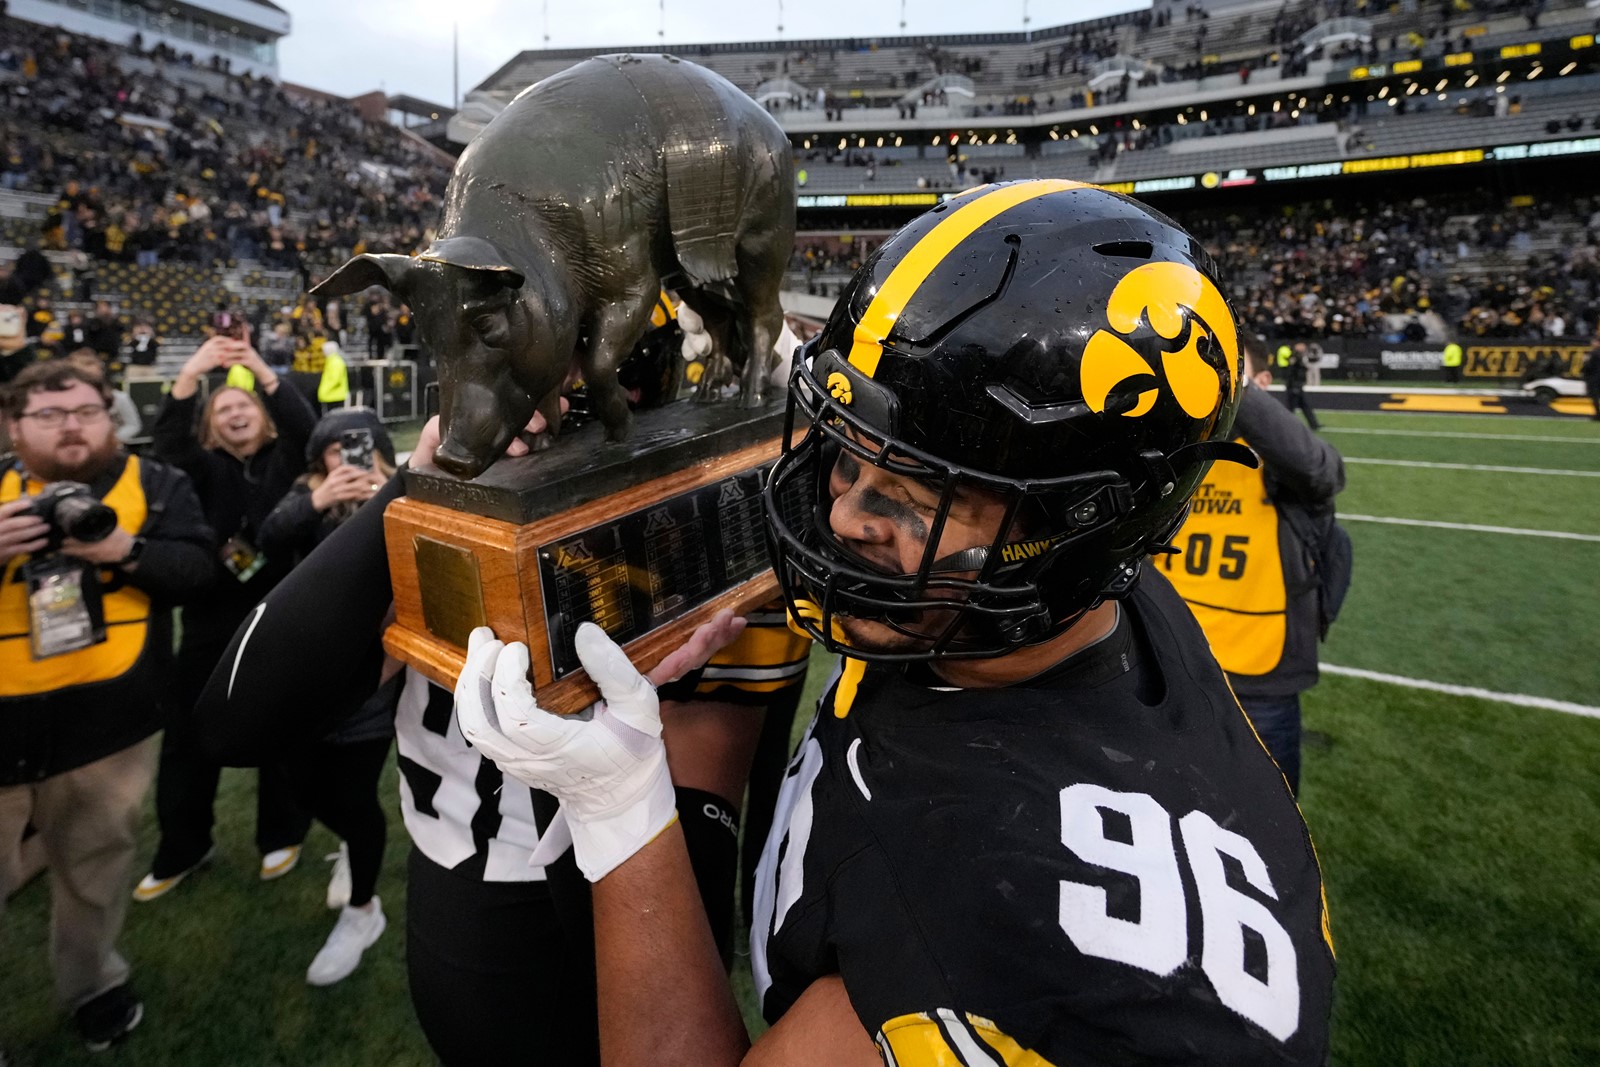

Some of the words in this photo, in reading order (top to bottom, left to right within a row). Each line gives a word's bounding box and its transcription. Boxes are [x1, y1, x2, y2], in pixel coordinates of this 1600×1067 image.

[587, 576, 602, 588] 2006
[588, 587, 602, 599] 2007
[1058, 782, 1300, 1042] 96
